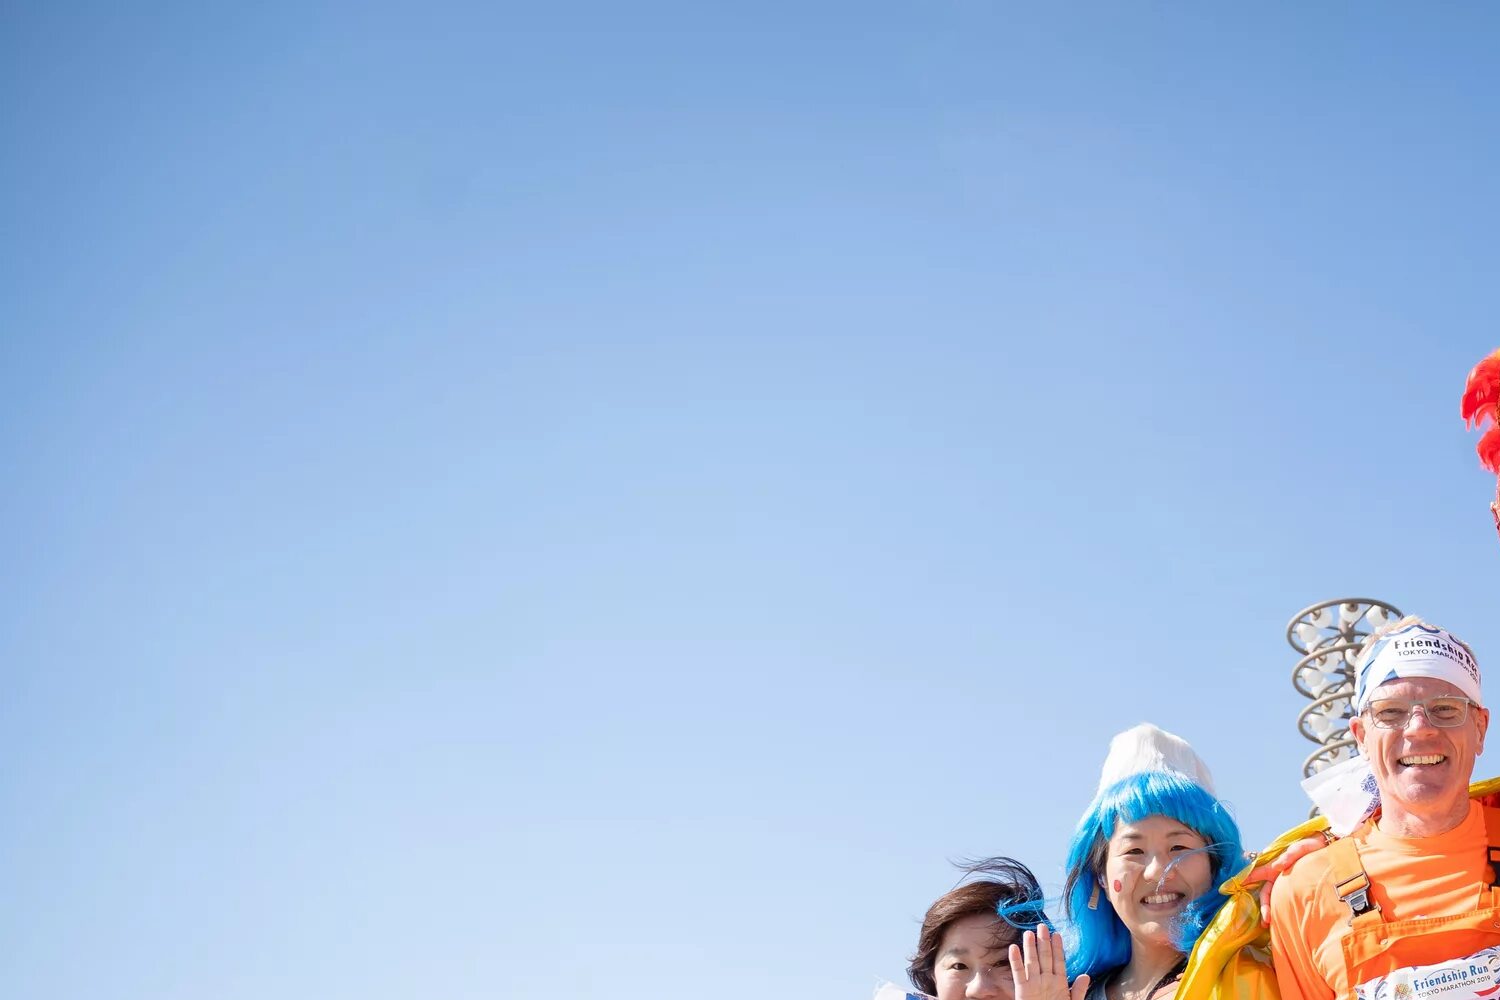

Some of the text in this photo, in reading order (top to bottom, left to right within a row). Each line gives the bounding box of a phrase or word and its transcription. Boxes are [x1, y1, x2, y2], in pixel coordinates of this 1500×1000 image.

[1394, 638, 1464, 660] Friendship
[1413, 964, 1489, 992] Friendship Run
[1417, 975, 1492, 999] TOKYO MARATHON 2019
